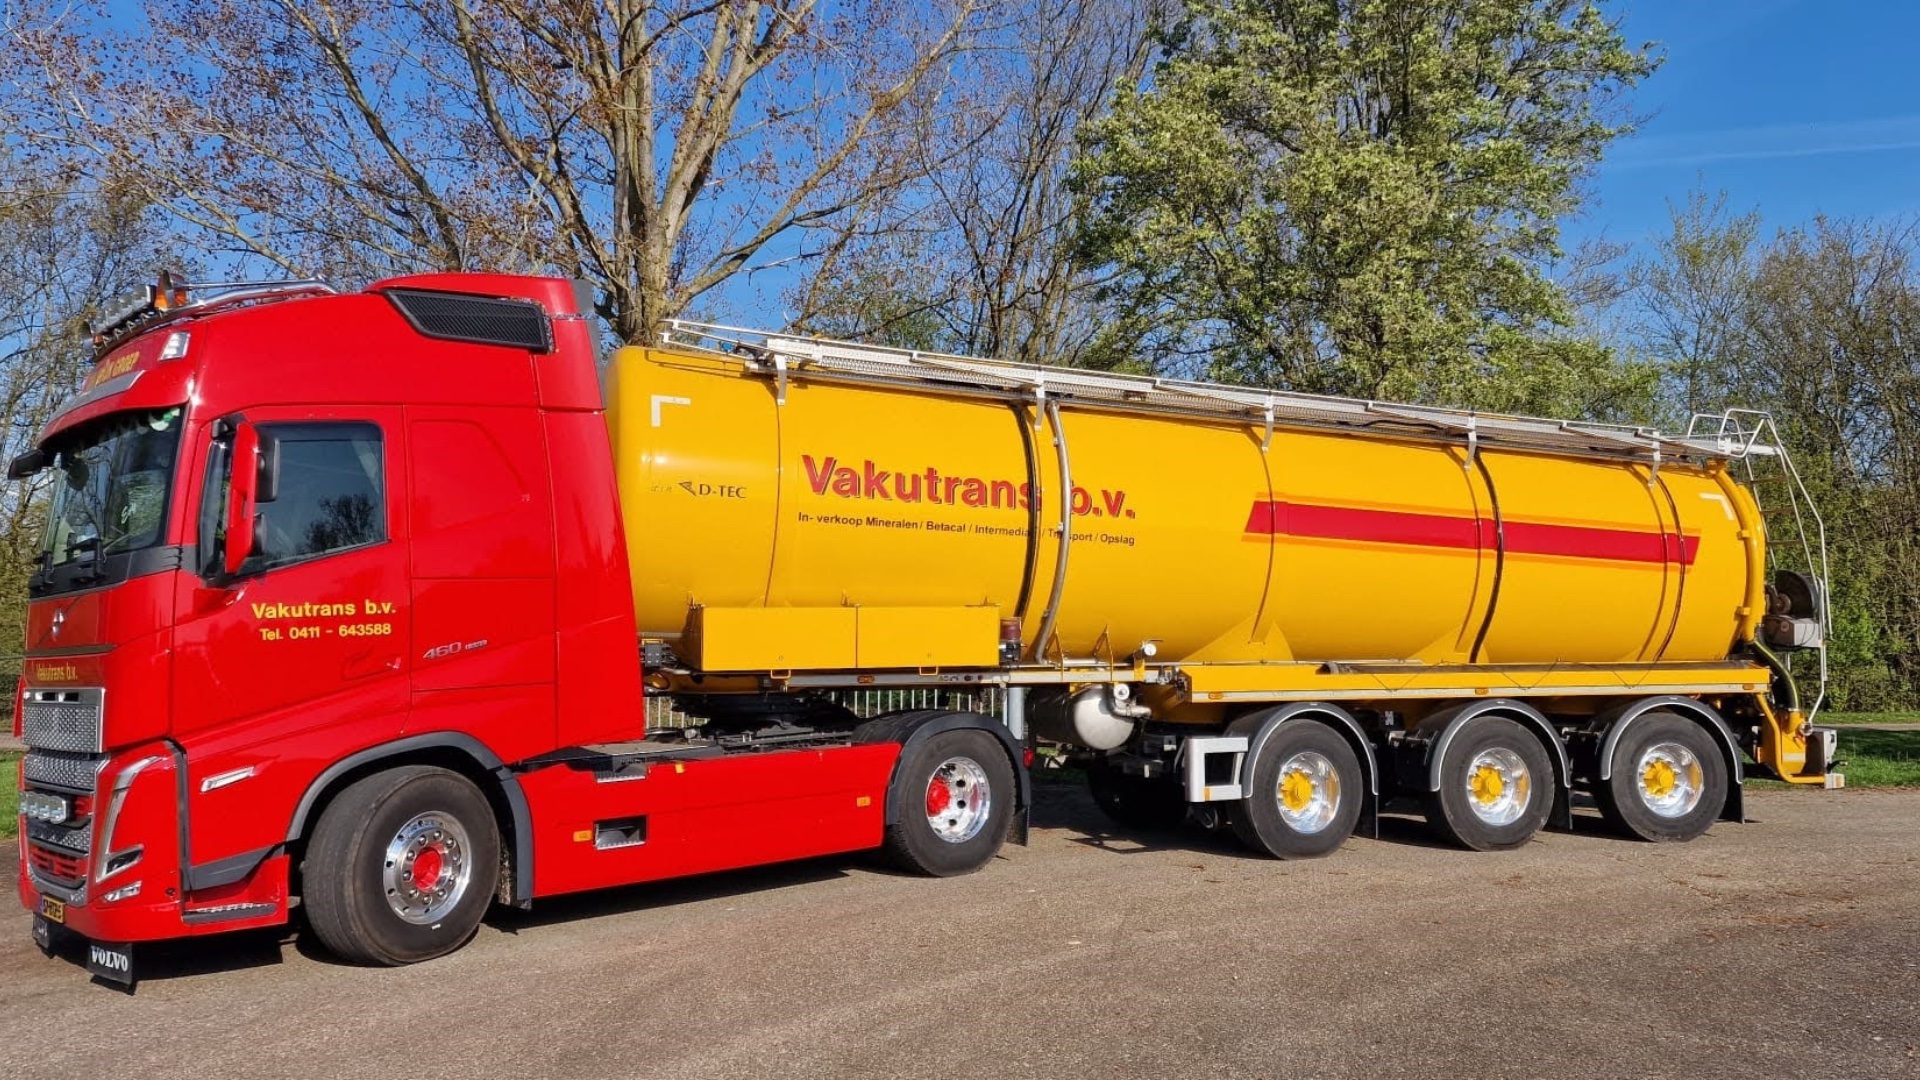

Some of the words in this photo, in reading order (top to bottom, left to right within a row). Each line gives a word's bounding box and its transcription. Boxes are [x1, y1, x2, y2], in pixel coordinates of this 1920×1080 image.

[699, 483, 747, 499] D-TEC
[801, 454, 1042, 512] Vakutrans
[1071, 479, 1136, 519] b.v.
[817, 514, 863, 526] verkoop
[926, 521, 966, 533] Betacal
[1100, 533, 1135, 546] Opslag
[252, 602, 356, 619] Vakutrans
[365, 599, 397, 615] b.v.
[260, 628, 283, 641] Tel.
[289, 626, 320, 640] 0411
[338, 623, 392, 637] 643588
[422, 641, 462, 660] 460
[90, 945, 128, 972] VOLVO
